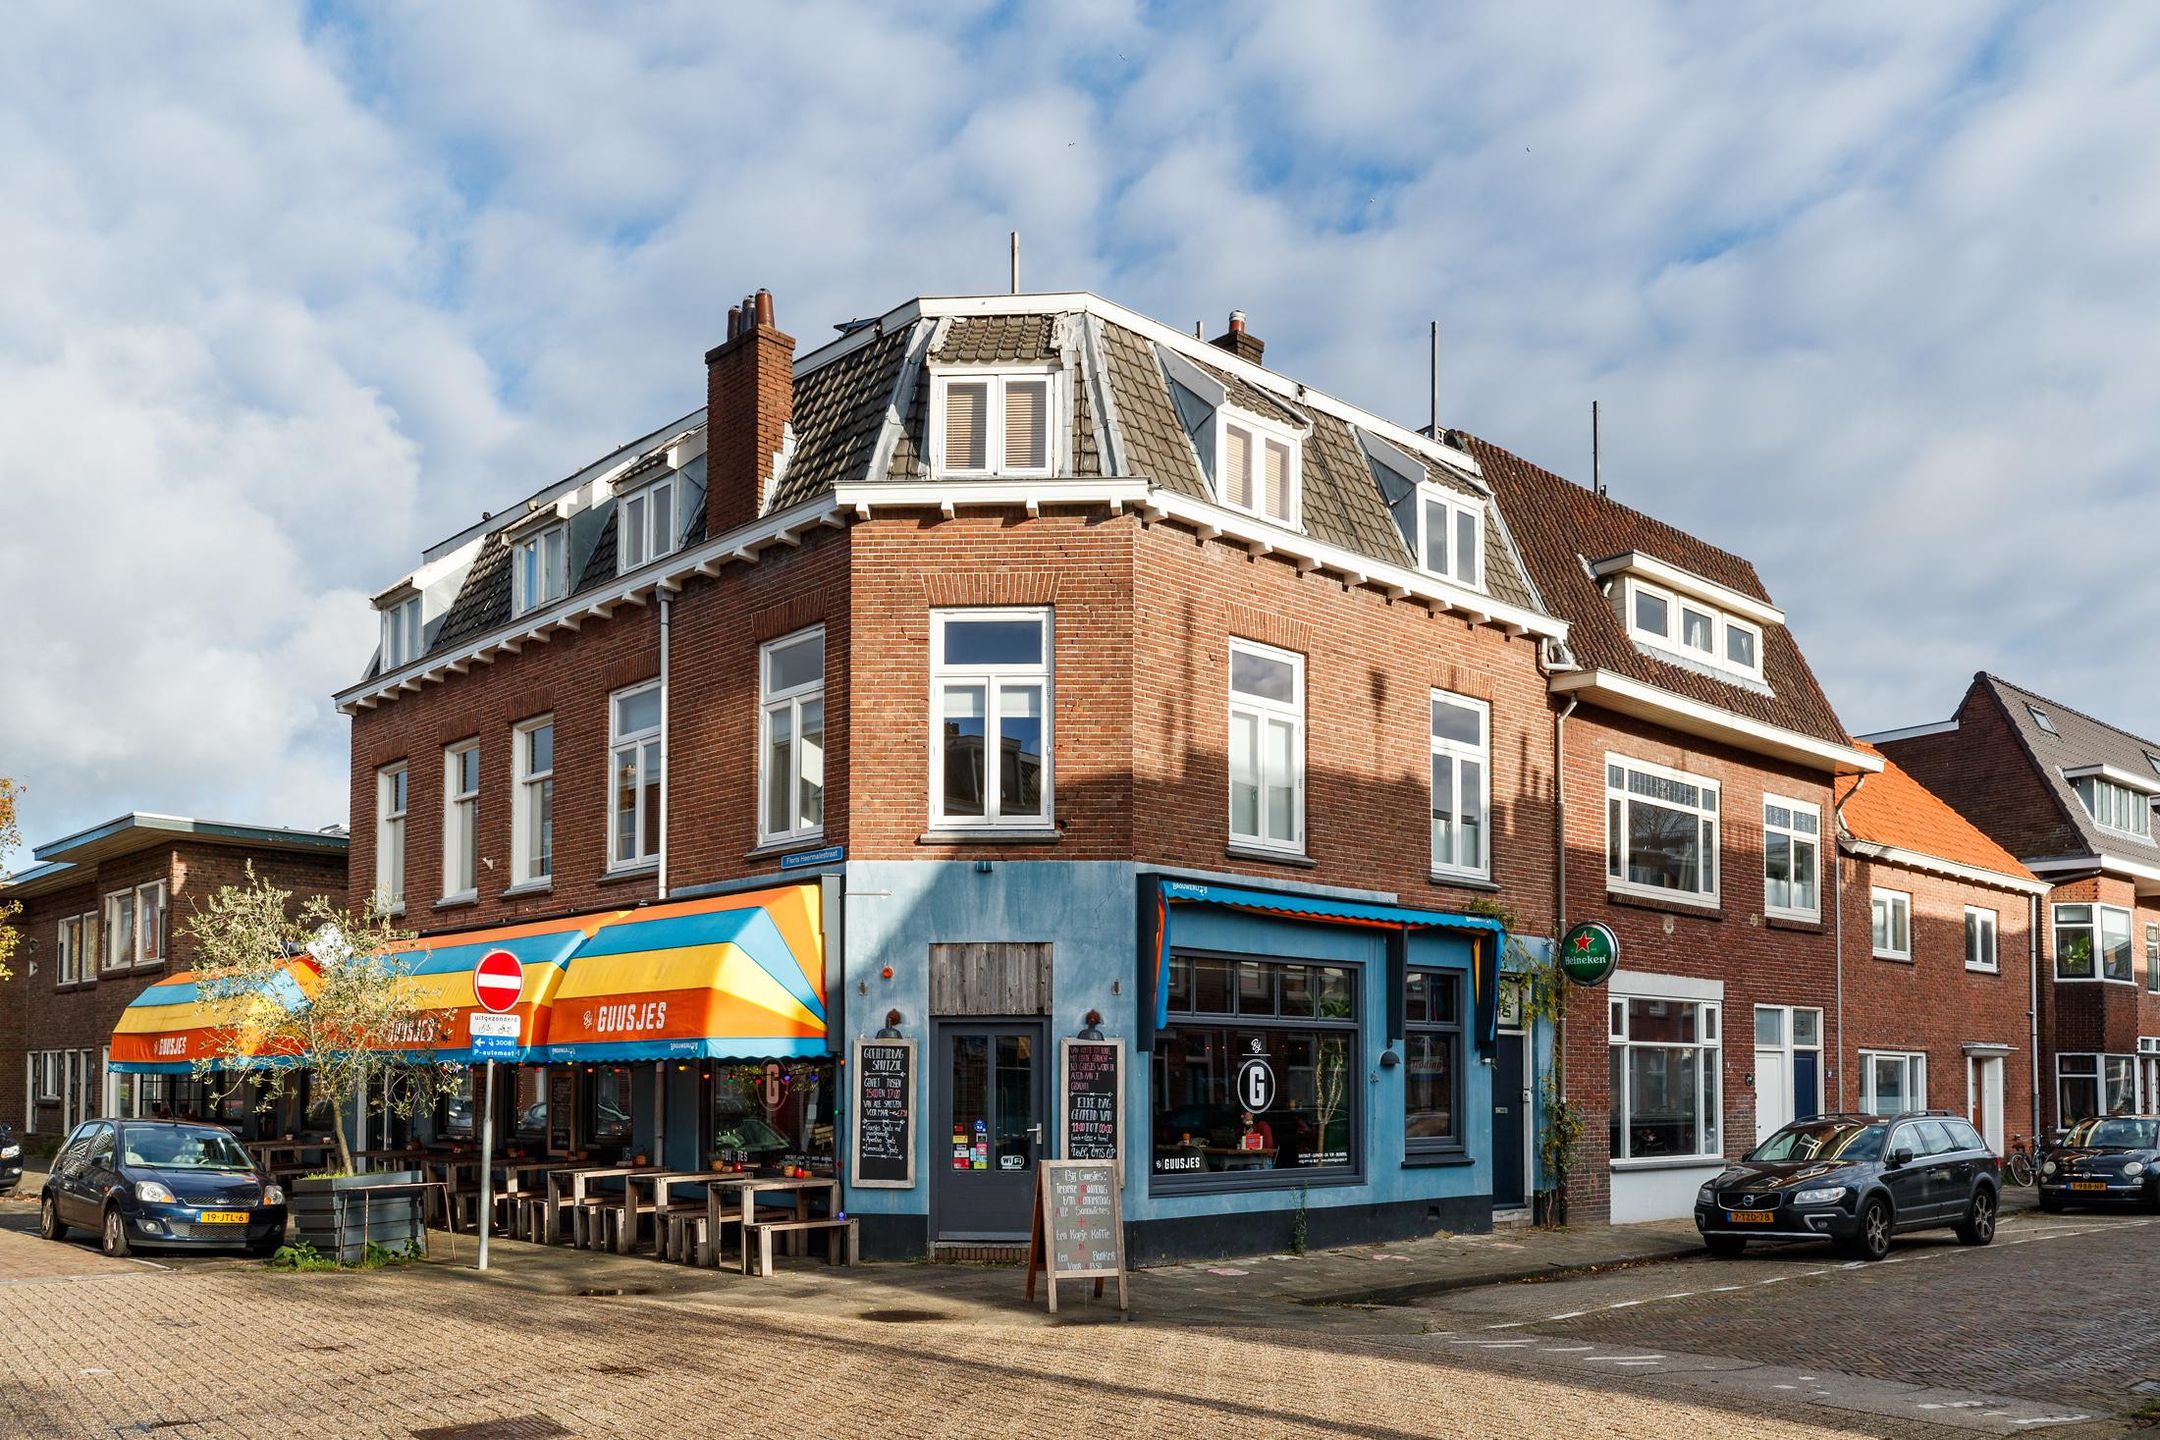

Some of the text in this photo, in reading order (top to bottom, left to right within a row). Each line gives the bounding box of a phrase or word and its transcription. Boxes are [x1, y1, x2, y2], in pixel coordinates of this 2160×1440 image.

[1565, 955, 1606, 965] Heineken
[597, 1002, 667, 1032] GUUSJES
[158, 1036, 187, 1055] GUUSJES
[1249, 1066, 1265, 1107] G
[1098, 1098, 1112, 1108] DAG
[1164, 1157, 1200, 1169] GUUSJES
[1065, 1169, 1076, 1183] Bij
[206, 1213, 244, 1222] 19-JTL-6
